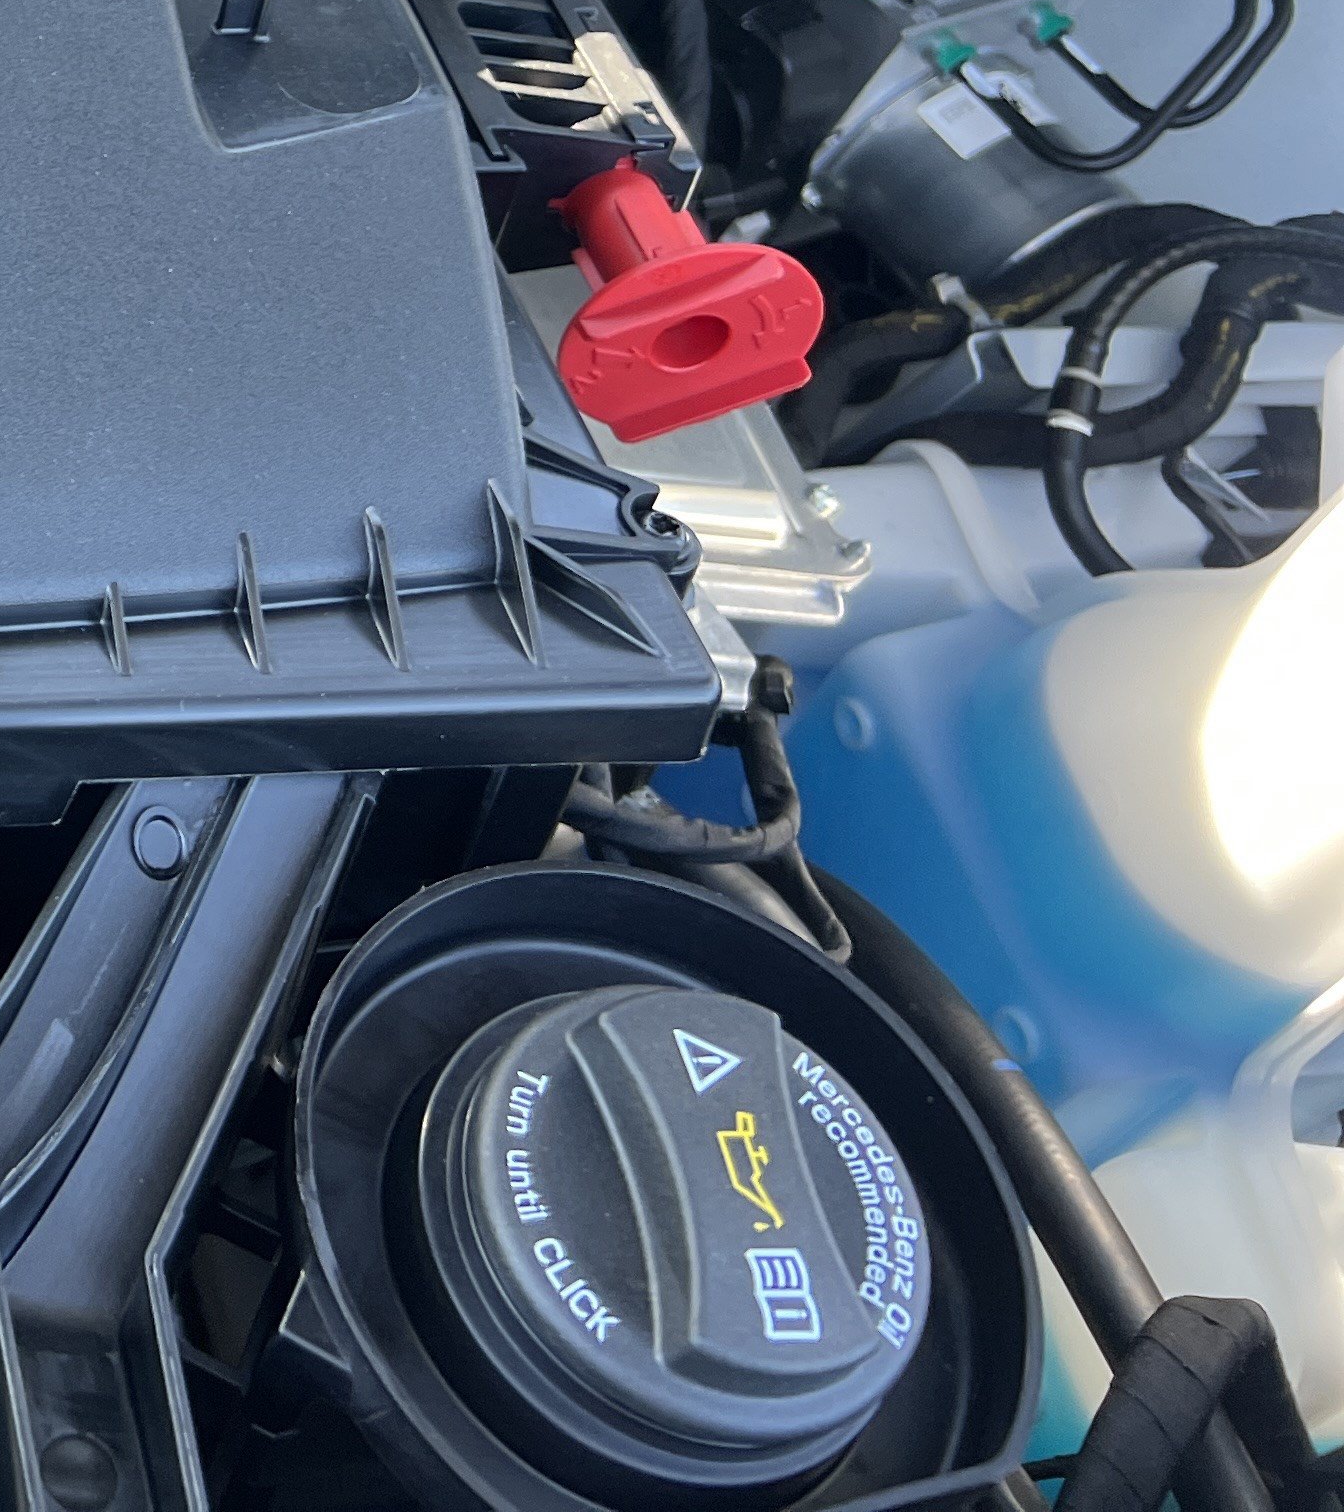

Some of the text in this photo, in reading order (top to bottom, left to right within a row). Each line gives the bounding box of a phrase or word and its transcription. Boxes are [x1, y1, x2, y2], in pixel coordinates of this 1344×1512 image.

[506, 1070, 622, 1344] Turn until CLICK
[792, 1051, 919, 1301] Mercedes-Benz
[797, 1090, 894, 1309] recommended
